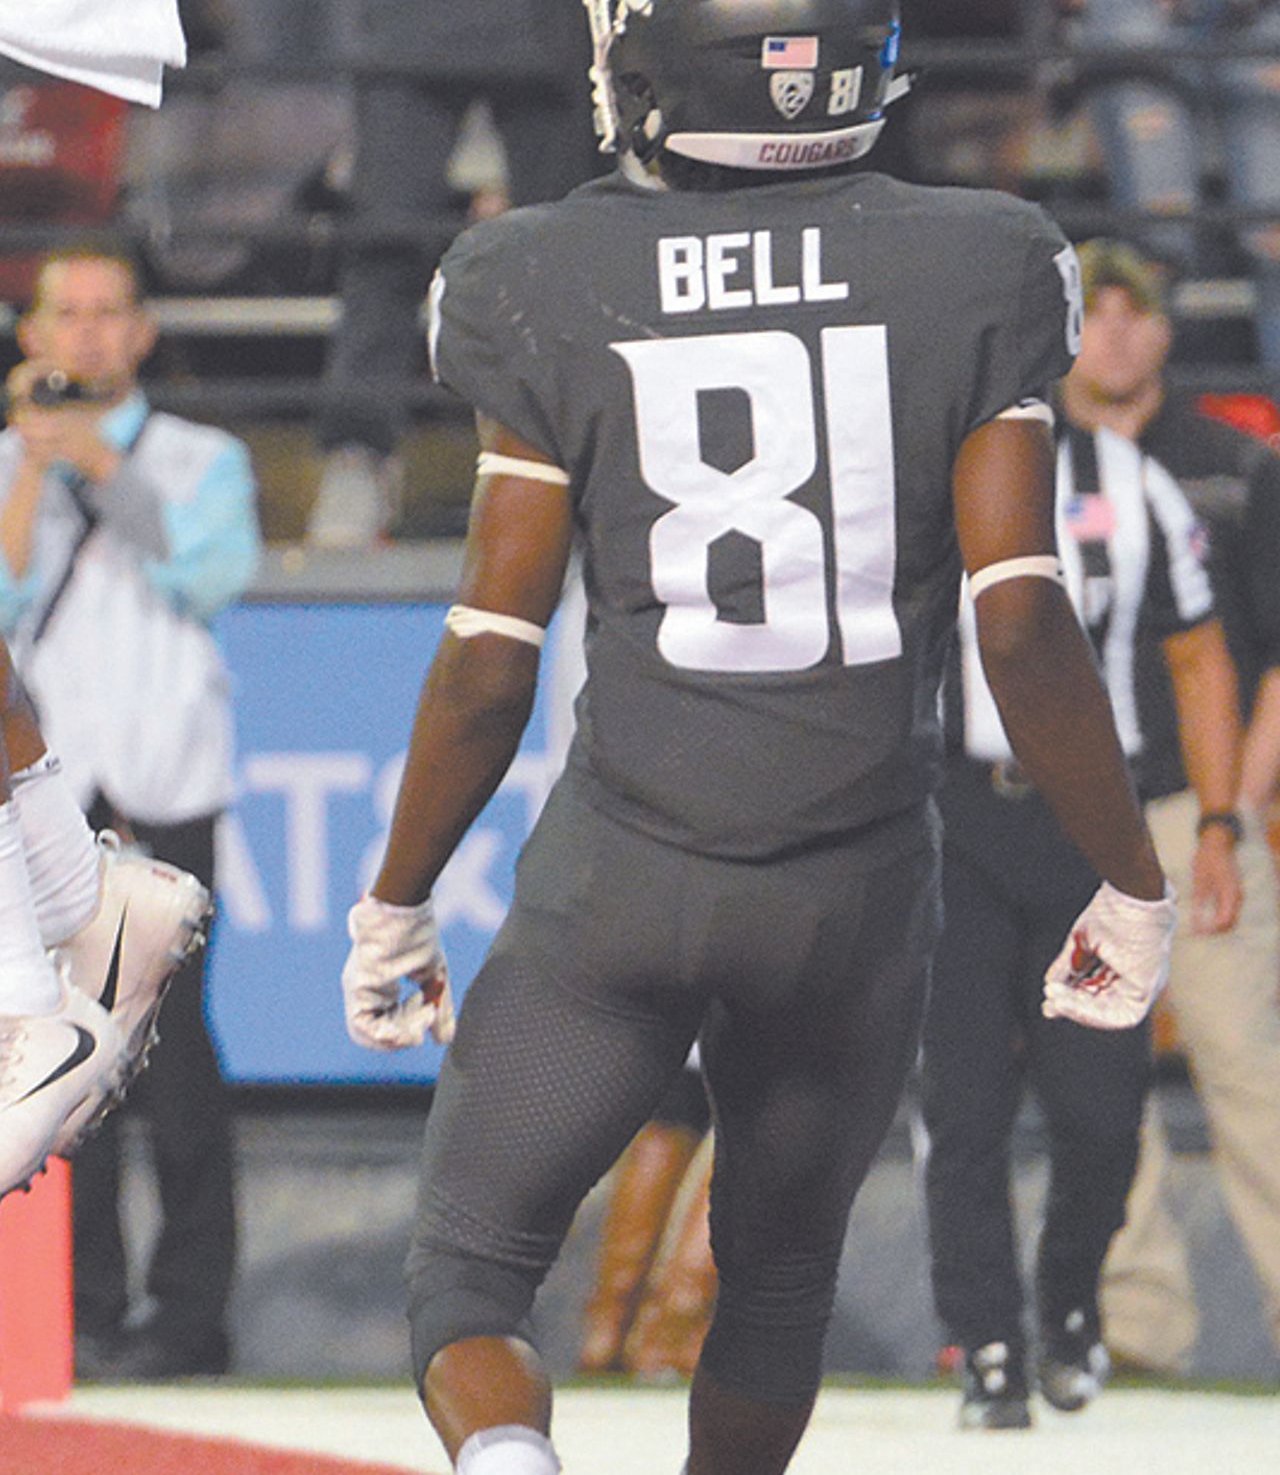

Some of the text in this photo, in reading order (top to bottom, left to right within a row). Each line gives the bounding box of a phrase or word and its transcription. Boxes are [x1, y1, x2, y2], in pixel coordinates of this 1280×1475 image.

[827, 66, 863, 116] 81
[757, 137, 859, 164] COUGARS
[658, 228, 849, 313] BELL
[608, 325, 902, 671] 81
